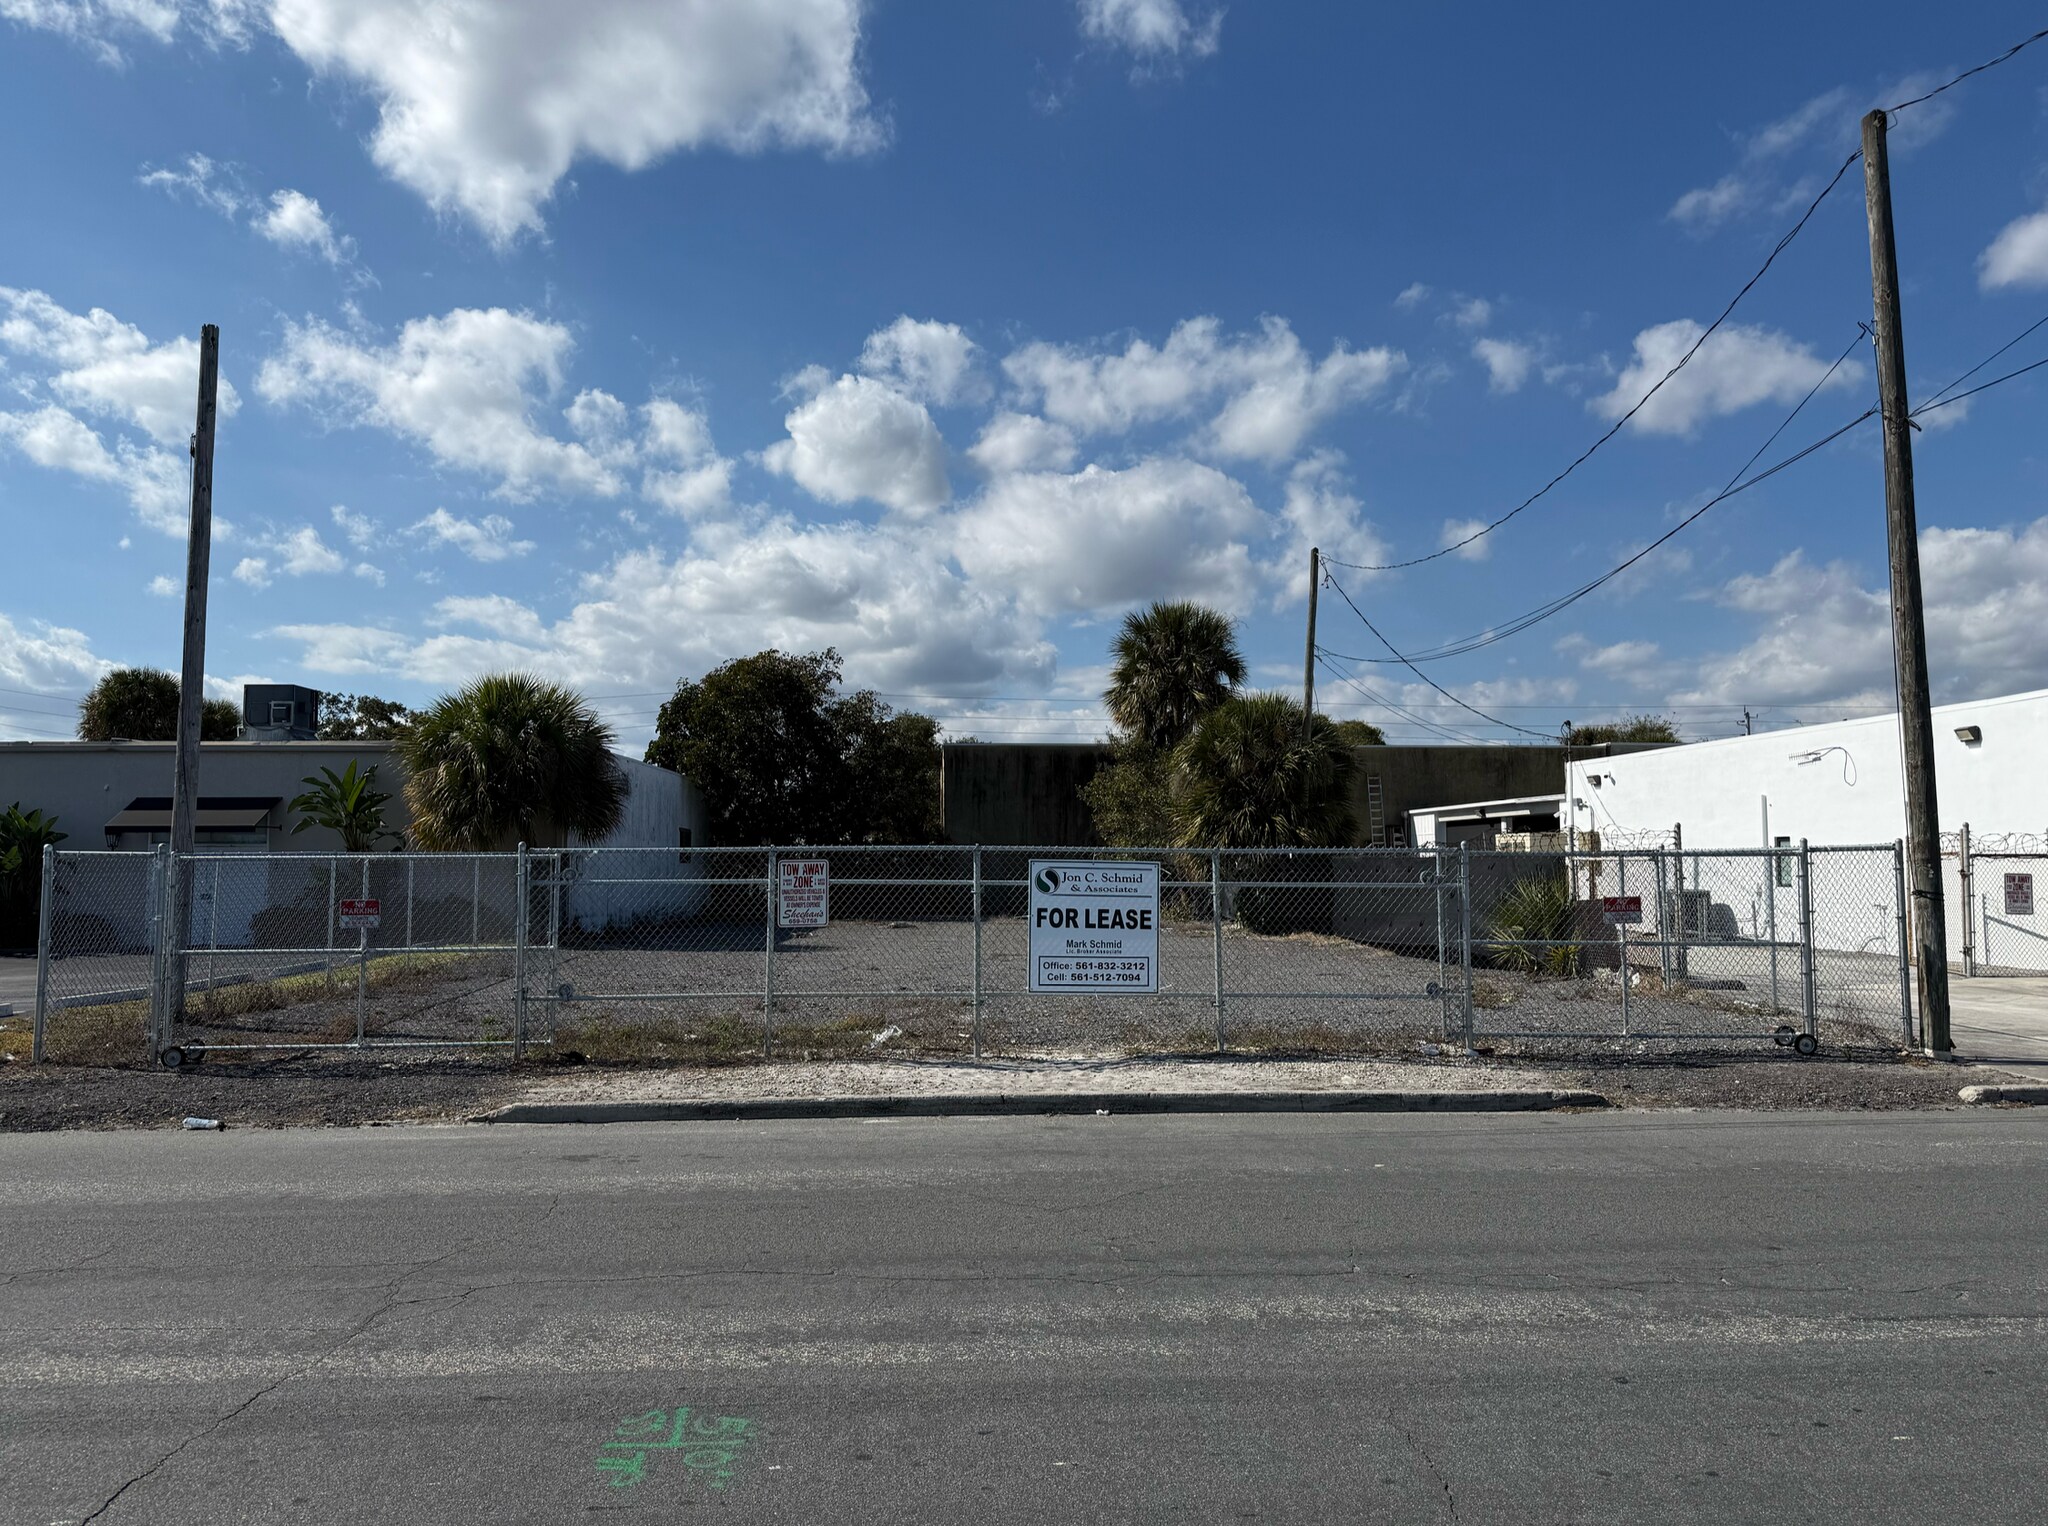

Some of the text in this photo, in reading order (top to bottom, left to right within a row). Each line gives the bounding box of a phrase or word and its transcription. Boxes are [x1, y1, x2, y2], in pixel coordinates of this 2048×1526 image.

[782, 863, 825, 876] TOW AWAY
[793, 875, 814, 889] ZONE
[1061, 871, 1143, 884] Jon C. Schmid
[1070, 883, 1139, 893] & Associates
[343, 907, 379, 915] PARKING
[1605, 904, 1640, 912] PARKING
[1036, 907, 1152, 930] FOR LEASE
[1066, 939, 1122, 949] Mark Schmid
[1042, 961, 1145, 971] Office: 561-832-3212
[1047, 972, 1141, 982] Cell: 561-512-7094
